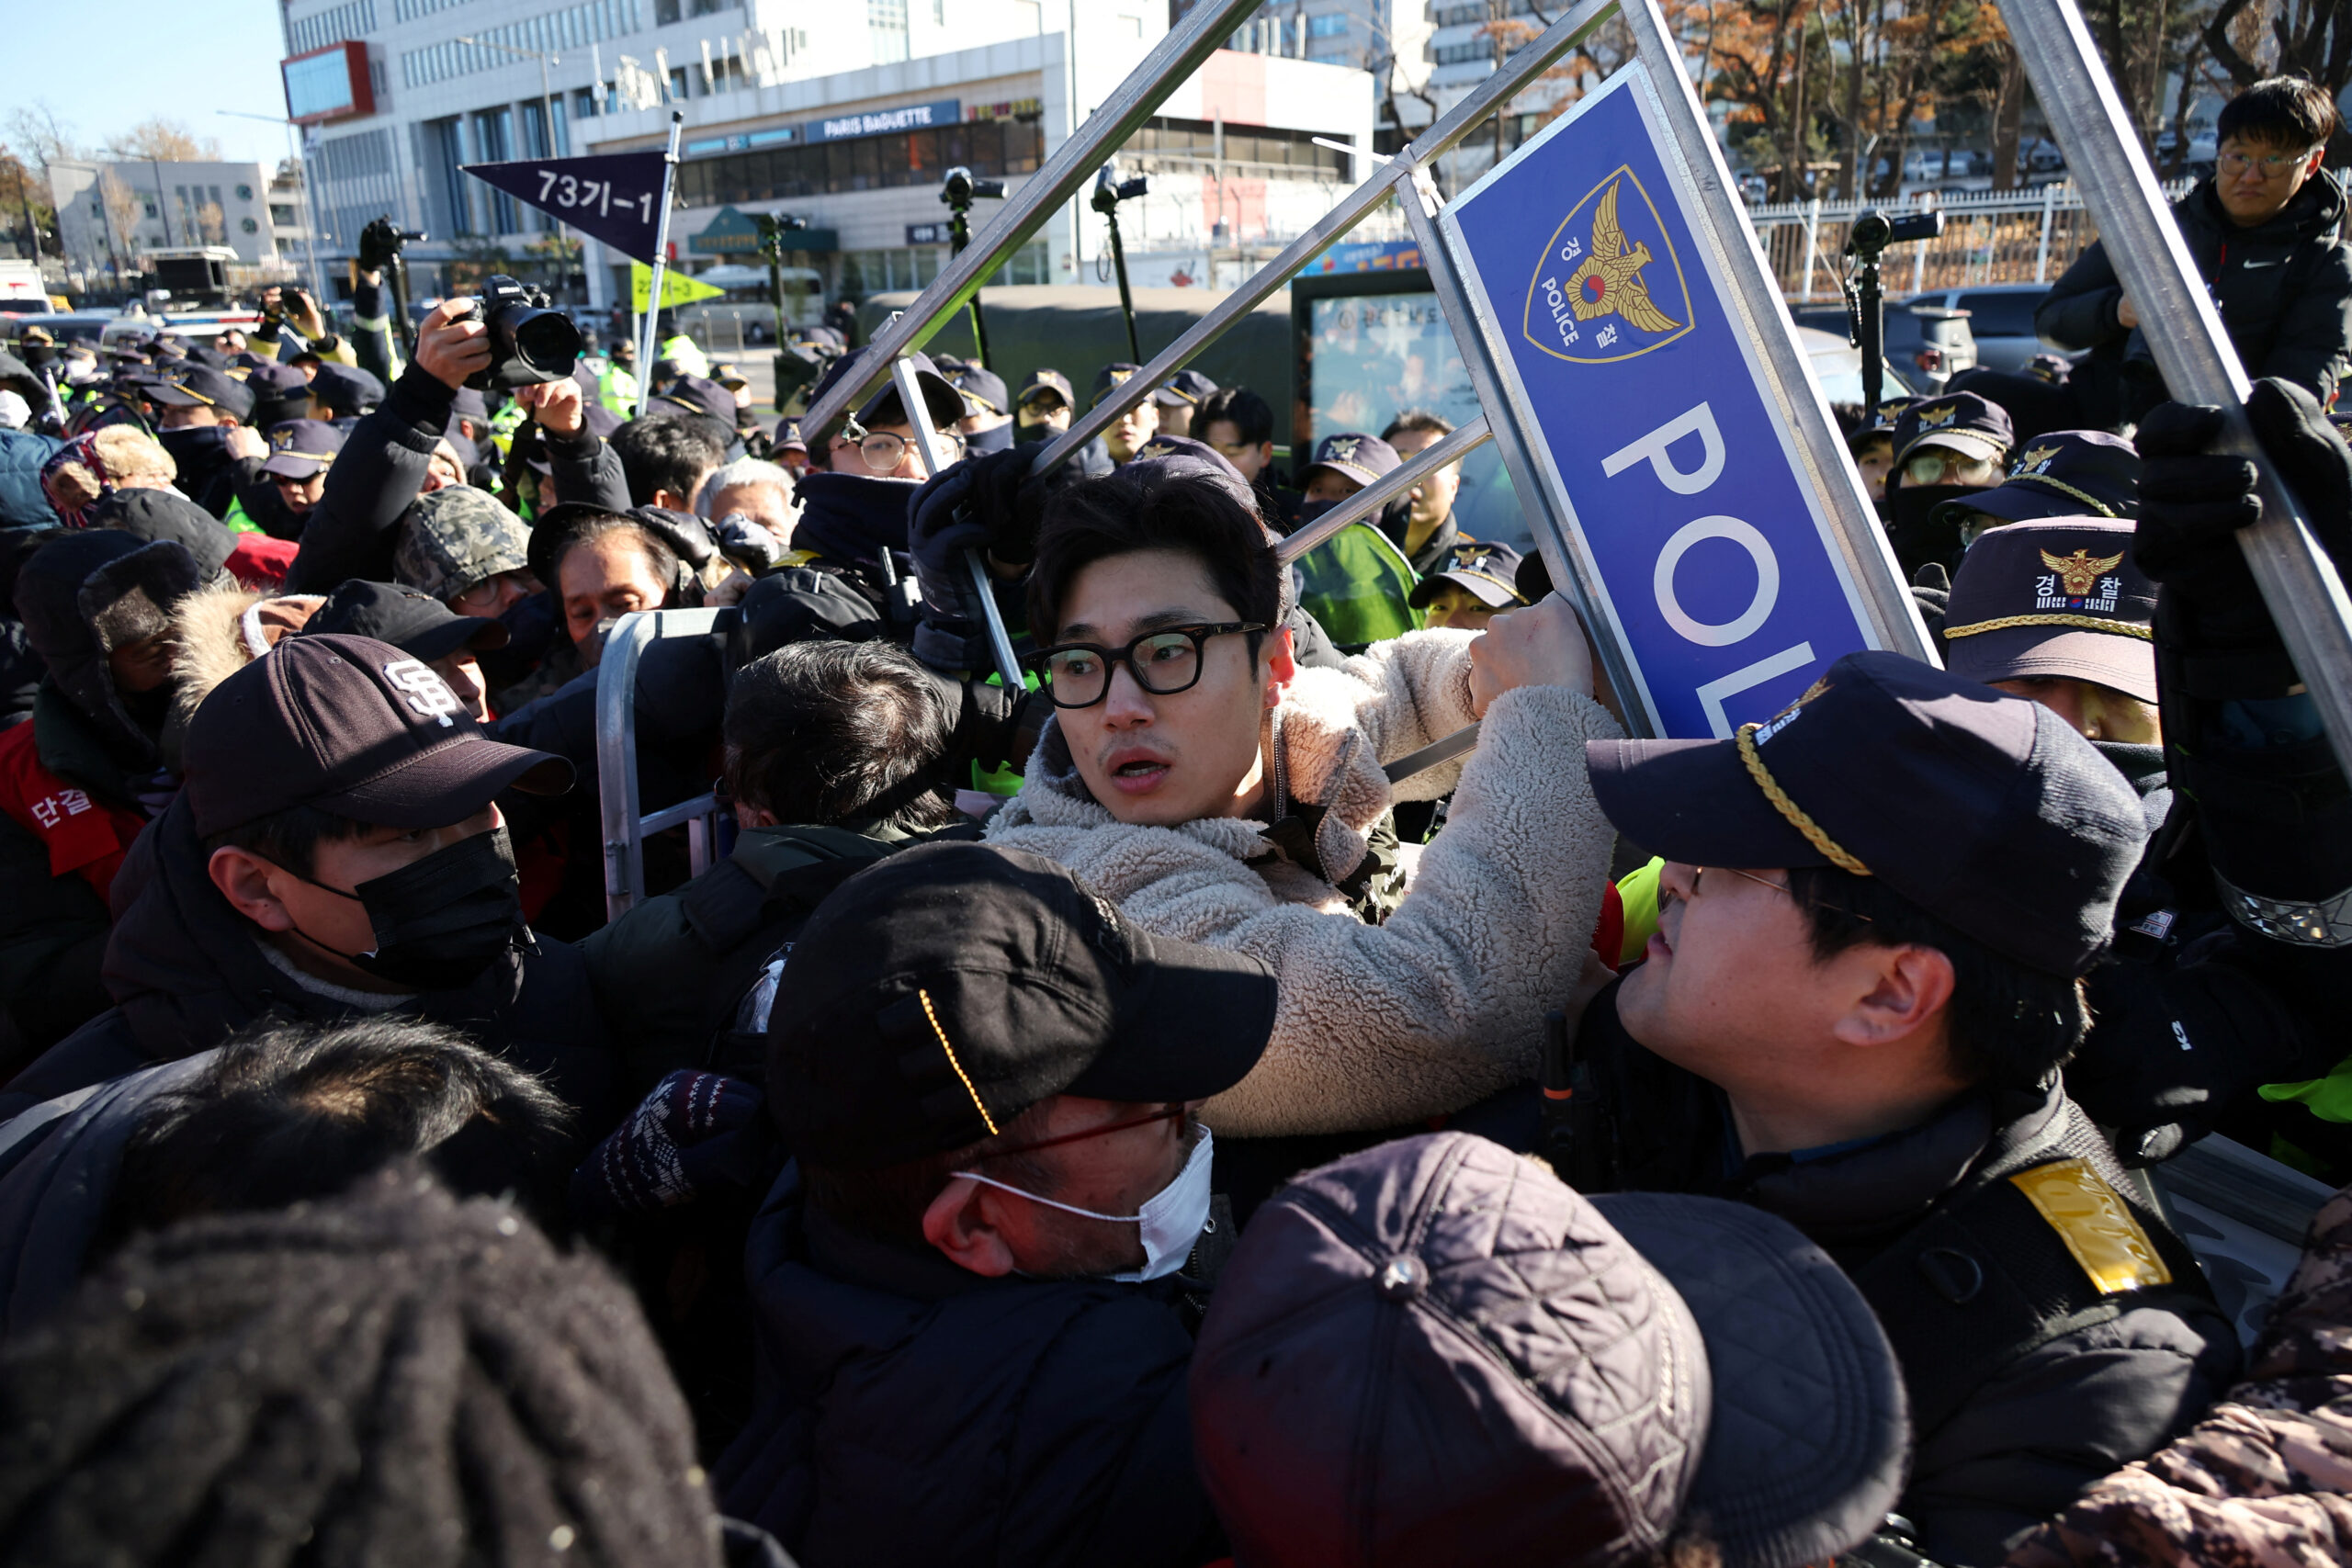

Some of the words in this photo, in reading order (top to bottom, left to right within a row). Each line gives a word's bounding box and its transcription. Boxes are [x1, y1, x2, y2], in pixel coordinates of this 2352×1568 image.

[824, 117, 863, 138] PARIS
[863, 106, 933, 133] BAGUETTE
[537, 169, 652, 224] 73기-1
[1541, 276, 1579, 347] POLICE
[1561, 236, 1582, 262] 경
[1595, 322, 1618, 349] 찰
[2035, 574, 2056, 597] 경
[2099, 577, 2122, 600] 찰
[31, 789, 92, 829] 단결
[2171, 1021, 2192, 1051] K2
